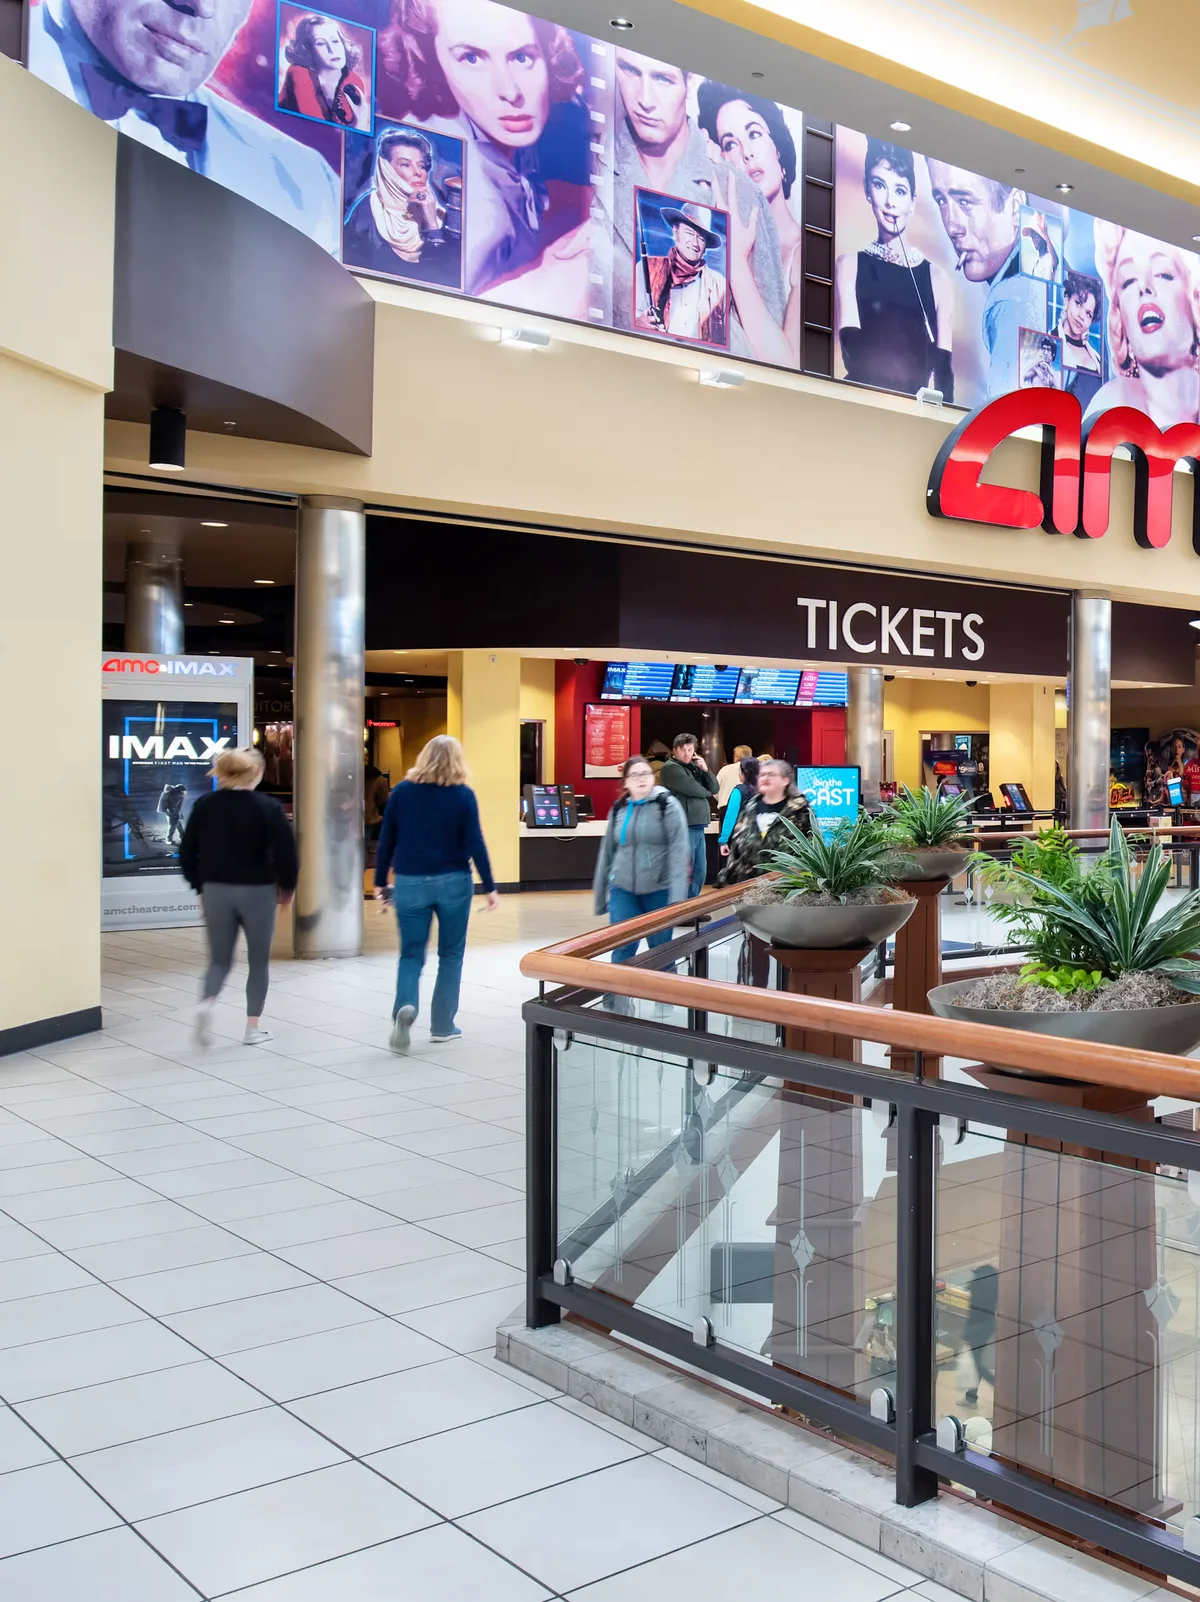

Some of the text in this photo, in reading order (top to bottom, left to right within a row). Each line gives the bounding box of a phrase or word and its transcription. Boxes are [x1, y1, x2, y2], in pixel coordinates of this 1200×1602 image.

[797, 597, 985, 661] TICKETS
[167, 661, 239, 677] IMAX
[109, 735, 231, 760] IMAX
[803, 788, 855, 806] CAST
[104, 904, 200, 916] amctheatres.com
